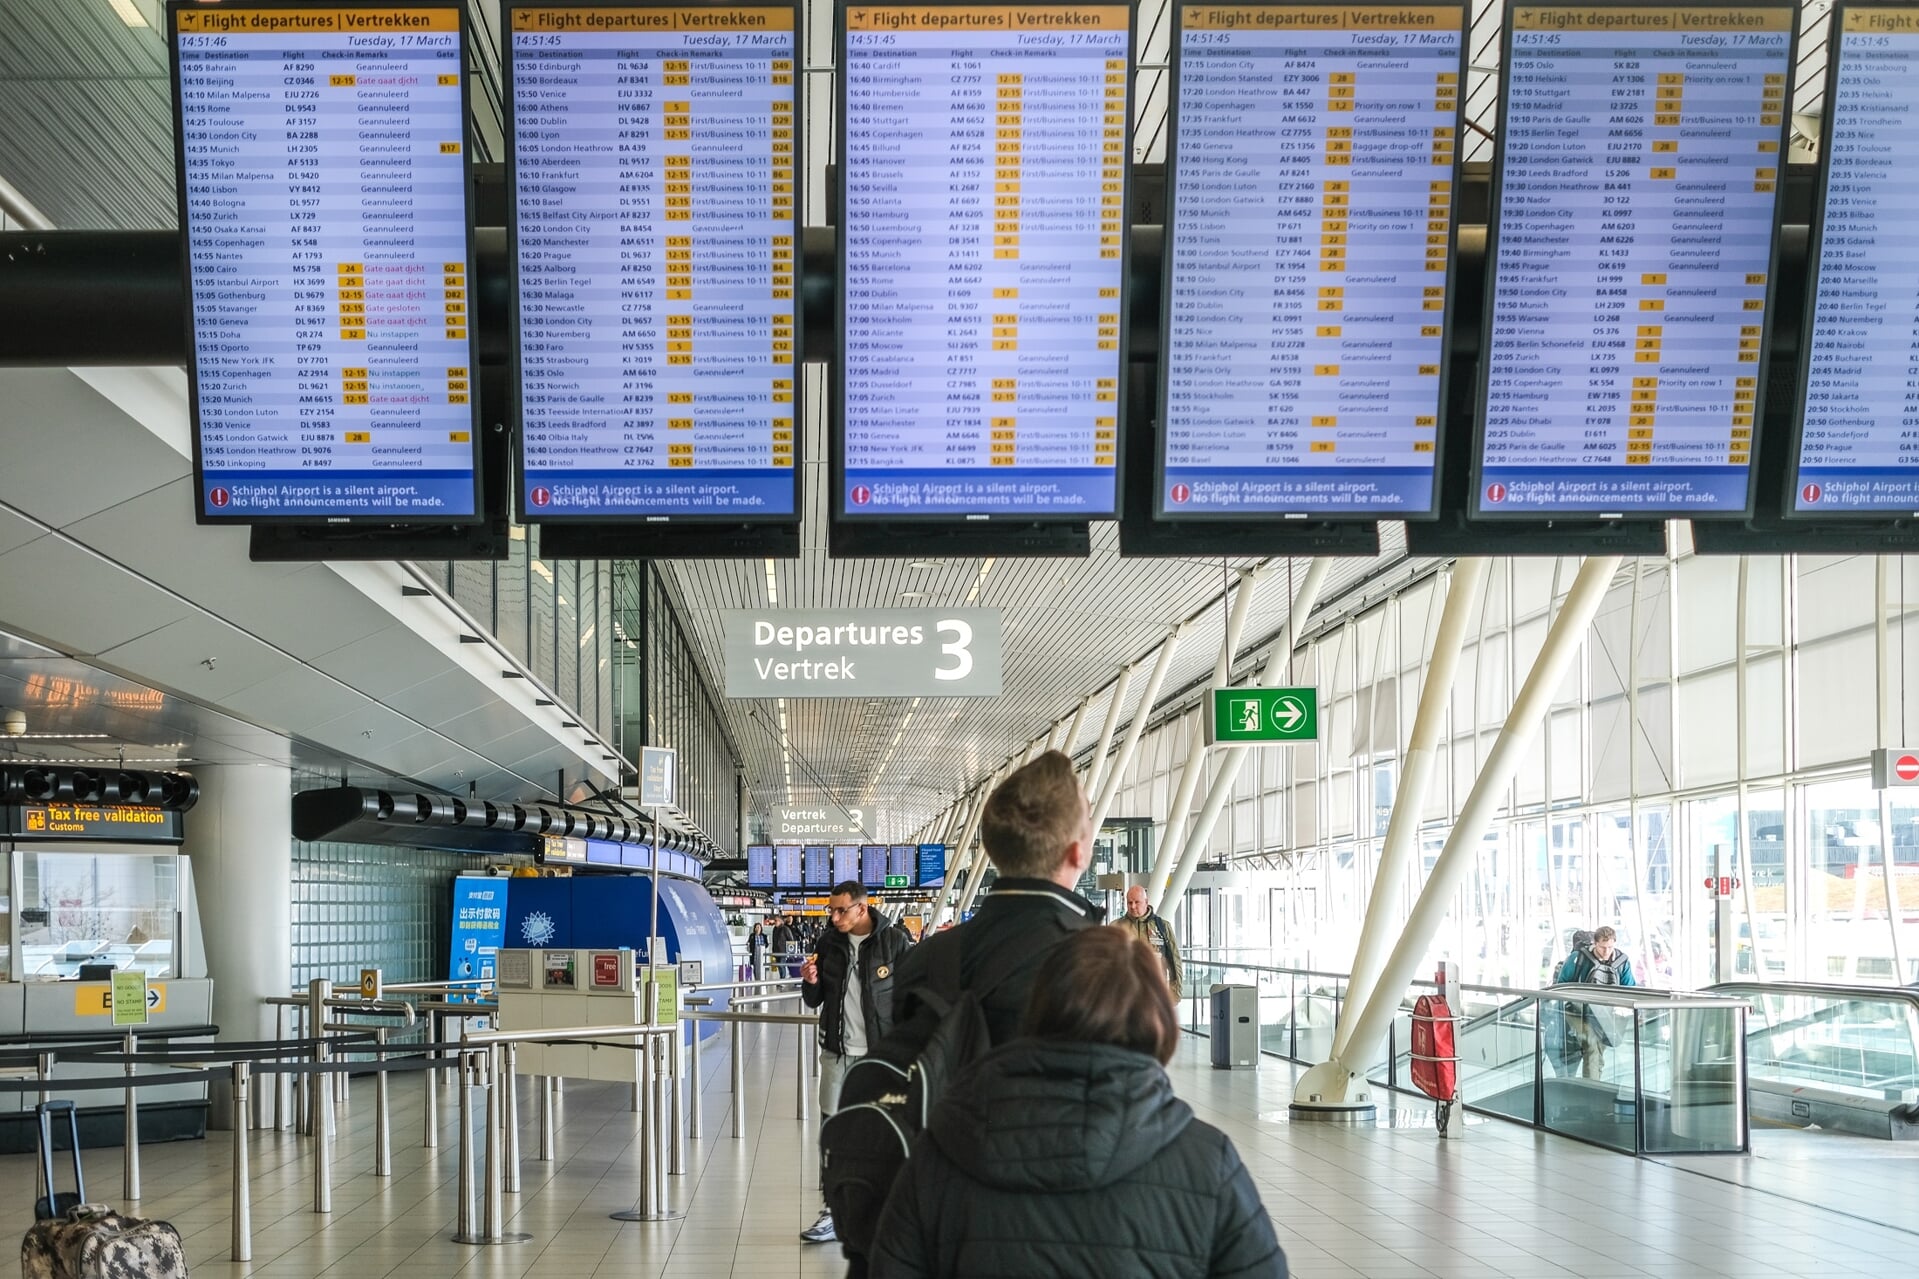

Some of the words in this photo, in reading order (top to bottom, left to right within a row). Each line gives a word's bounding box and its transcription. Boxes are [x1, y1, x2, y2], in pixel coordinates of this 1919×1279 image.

[203, 15, 248, 29] Flight
[252, 15, 333, 29] departures
[346, 14, 430, 26] Vertrekken
[538, 13, 581, 27] Flight
[587, 13, 668, 27] departures
[681, 13, 766, 25] Vertrekken
[874, 13, 916, 27] Flight
[921, 12, 1003, 27] departures
[1017, 12, 1100, 24] Vertrekken
[1208, 12, 1252, 26] Flight
[1257, 12, 1338, 25] departures
[1352, 12, 1434, 24] Vertrekken
[1540, 13, 1582, 27] Flight
[1587, 13, 1668, 27] departures
[1683, 13, 1763, 26] Vertrekken
[1870, 15, 1911, 28] Flight
[181, 37, 227, 47] 14:51:46
[348, 36, 396, 47] Tuesday,
[400, 37, 412, 46] 17
[417, 36, 451, 45] March
[515, 36, 561, 45] 14:51:45
[683, 35, 731, 46] Tuesday,
[735, 35, 748, 45] 17
[752, 35, 787, 45] March
[850, 35, 896, 44] 14:51:45
[1018, 34, 1065, 45] Tuesday,
[1070, 34, 1082, 43] 17
[1086, 34, 1121, 44] March
[1185, 34, 1230, 43] 14:51:45
[1351, 34, 1398, 44] Tuesday,
[1403, 34, 1416, 43] 17
[1419, 34, 1454, 44] March
[1515, 35, 1560, 44] 14:51:45
[1681, 35, 1727, 45] Tuesday,
[1732, 35, 1745, 44] 17
[1748, 35, 1783, 44] March
[1845, 37, 1889, 46] 14:51:45
[283, 52, 304, 60] Flight
[182, 64, 204, 72] 14:05
[1237, 61, 1255, 70] City
[1685, 62, 1737, 70] Geannuleerd
[1865, 64, 1908, 72] Strasbourg
[1205, 88, 1235, 96] London
[1337, 88, 1347, 96] 17
[1437, 88, 1453, 96] D24
[227, 460, 266, 468] Linkoping
[232, 486, 277, 497] Schiphol
[281, 486, 320, 497] Airport
[323, 486, 331, 495] is
[344, 486, 374, 495] silent
[378, 486, 418, 497] airport.
[1510, 481, 1555, 493] Schiphol
[1558, 481, 1596, 493] Airport
[1600, 482, 1608, 491] is
[1611, 483, 1617, 491] a
[1620, 481, 1649, 491] silent
[1653, 481, 1693, 493] airport.
[1825, 482, 1870, 494] Schiphol
[1872, 483, 1911, 494] Airport
[232, 497, 248, 506] No
[251, 496, 280, 508] flight
[283, 498, 369, 507] announcements
[372, 496, 390, 506] will
[395, 496, 408, 506] be
[411, 496, 444, 506] made.
[1508, 493, 1524, 502] No
[1527, 492, 1555, 503] flight
[1557, 493, 1643, 502] announcements
[1646, 493, 1665, 502] will
[1669, 493, 1681, 502] be
[1685, 493, 1718, 502] made.
[1840, 494, 1870, 505] flight
[754, 622, 924, 651] Departures
[935, 619, 973, 681] 3
[754, 657, 856, 681] Vertrek
[49, 809, 70, 821] Tax
[75, 809, 100, 822] free
[104, 810, 163, 823] validation
[781, 809, 826, 820] Vertrek
[49, 822, 84, 831] Customs
[849, 810, 863, 832] 3
[781, 823, 843, 835] Departures
